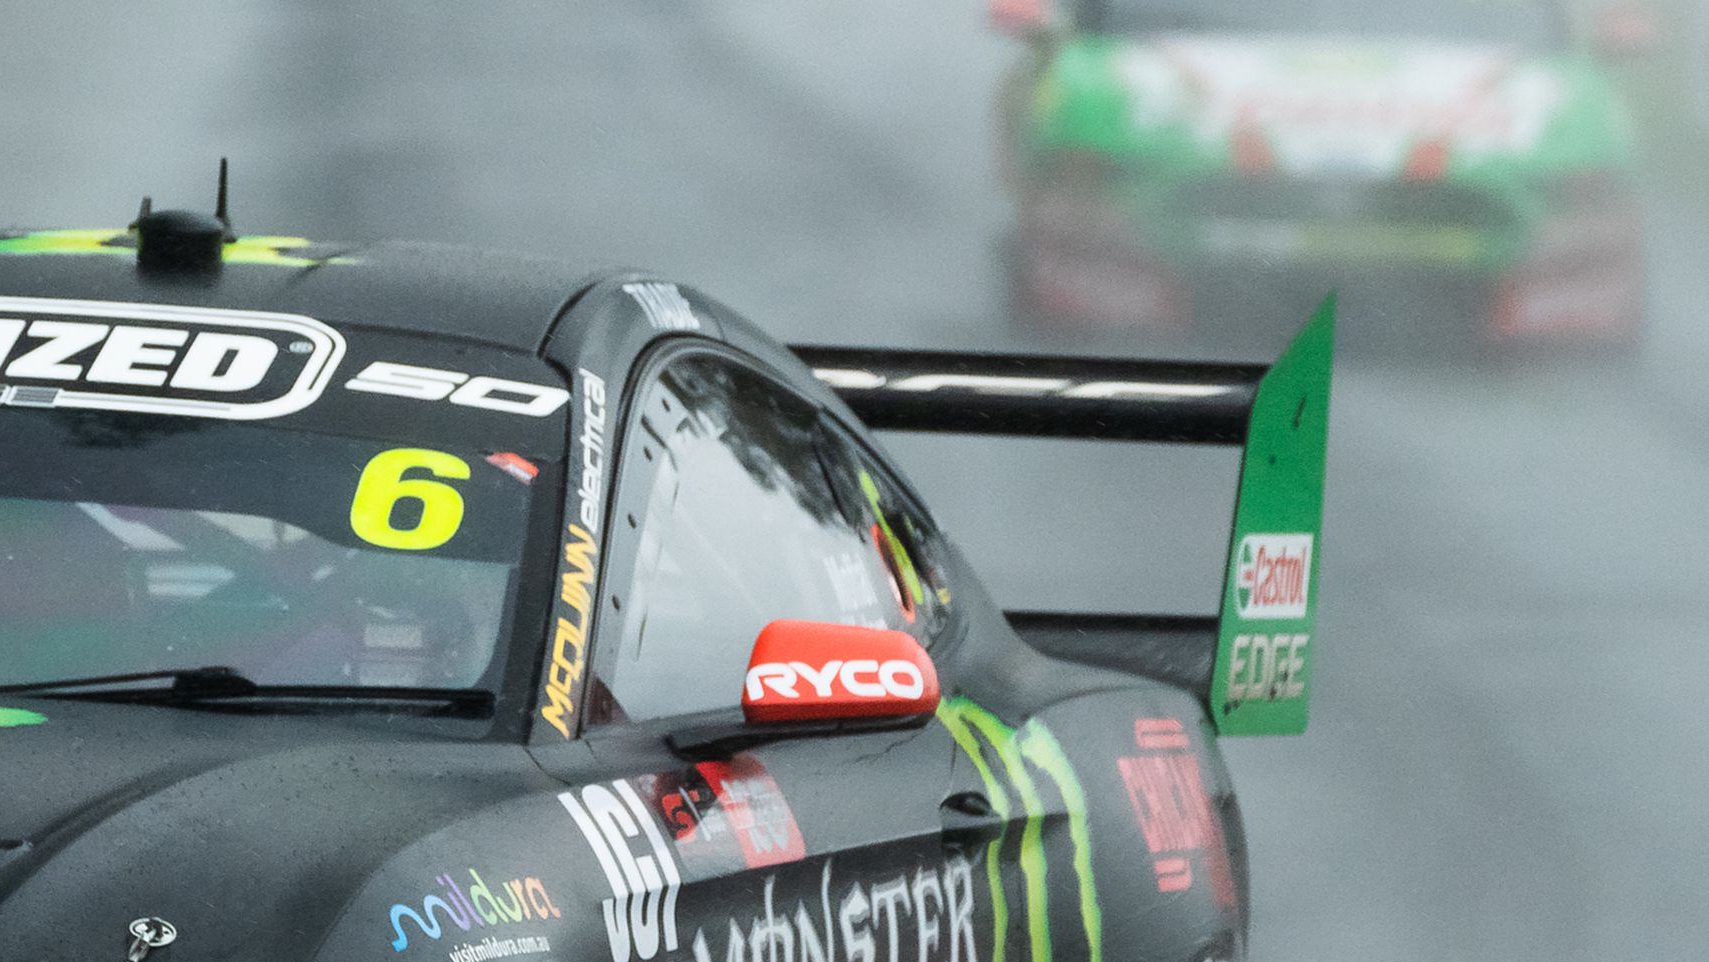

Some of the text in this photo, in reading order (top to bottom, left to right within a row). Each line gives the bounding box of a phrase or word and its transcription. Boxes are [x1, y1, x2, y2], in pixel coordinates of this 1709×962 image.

[345, 361, 571, 416] 50
[579, 366, 607, 534] electrical
[350, 447, 471, 550] 6
[745, 660, 924, 700] RYCO
[1227, 633, 1310, 701] EDGE
[390, 868, 562, 953] mildura
